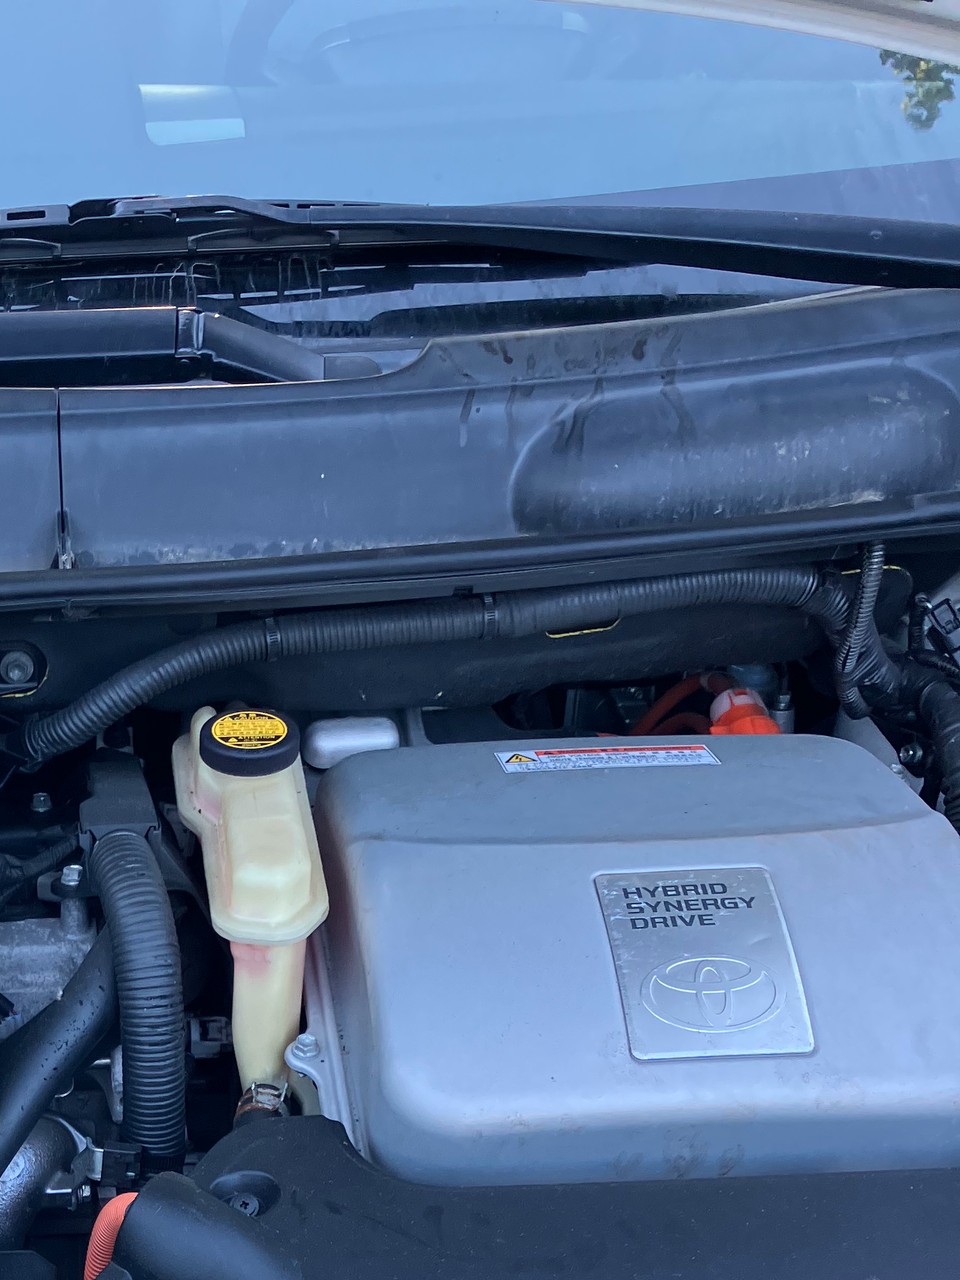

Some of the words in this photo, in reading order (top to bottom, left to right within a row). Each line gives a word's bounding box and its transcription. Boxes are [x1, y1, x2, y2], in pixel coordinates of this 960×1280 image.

[622, 882, 728, 900] HYBRID
[626, 896, 756, 915] SYNERGY
[630, 913, 716, 930] DRIVE
